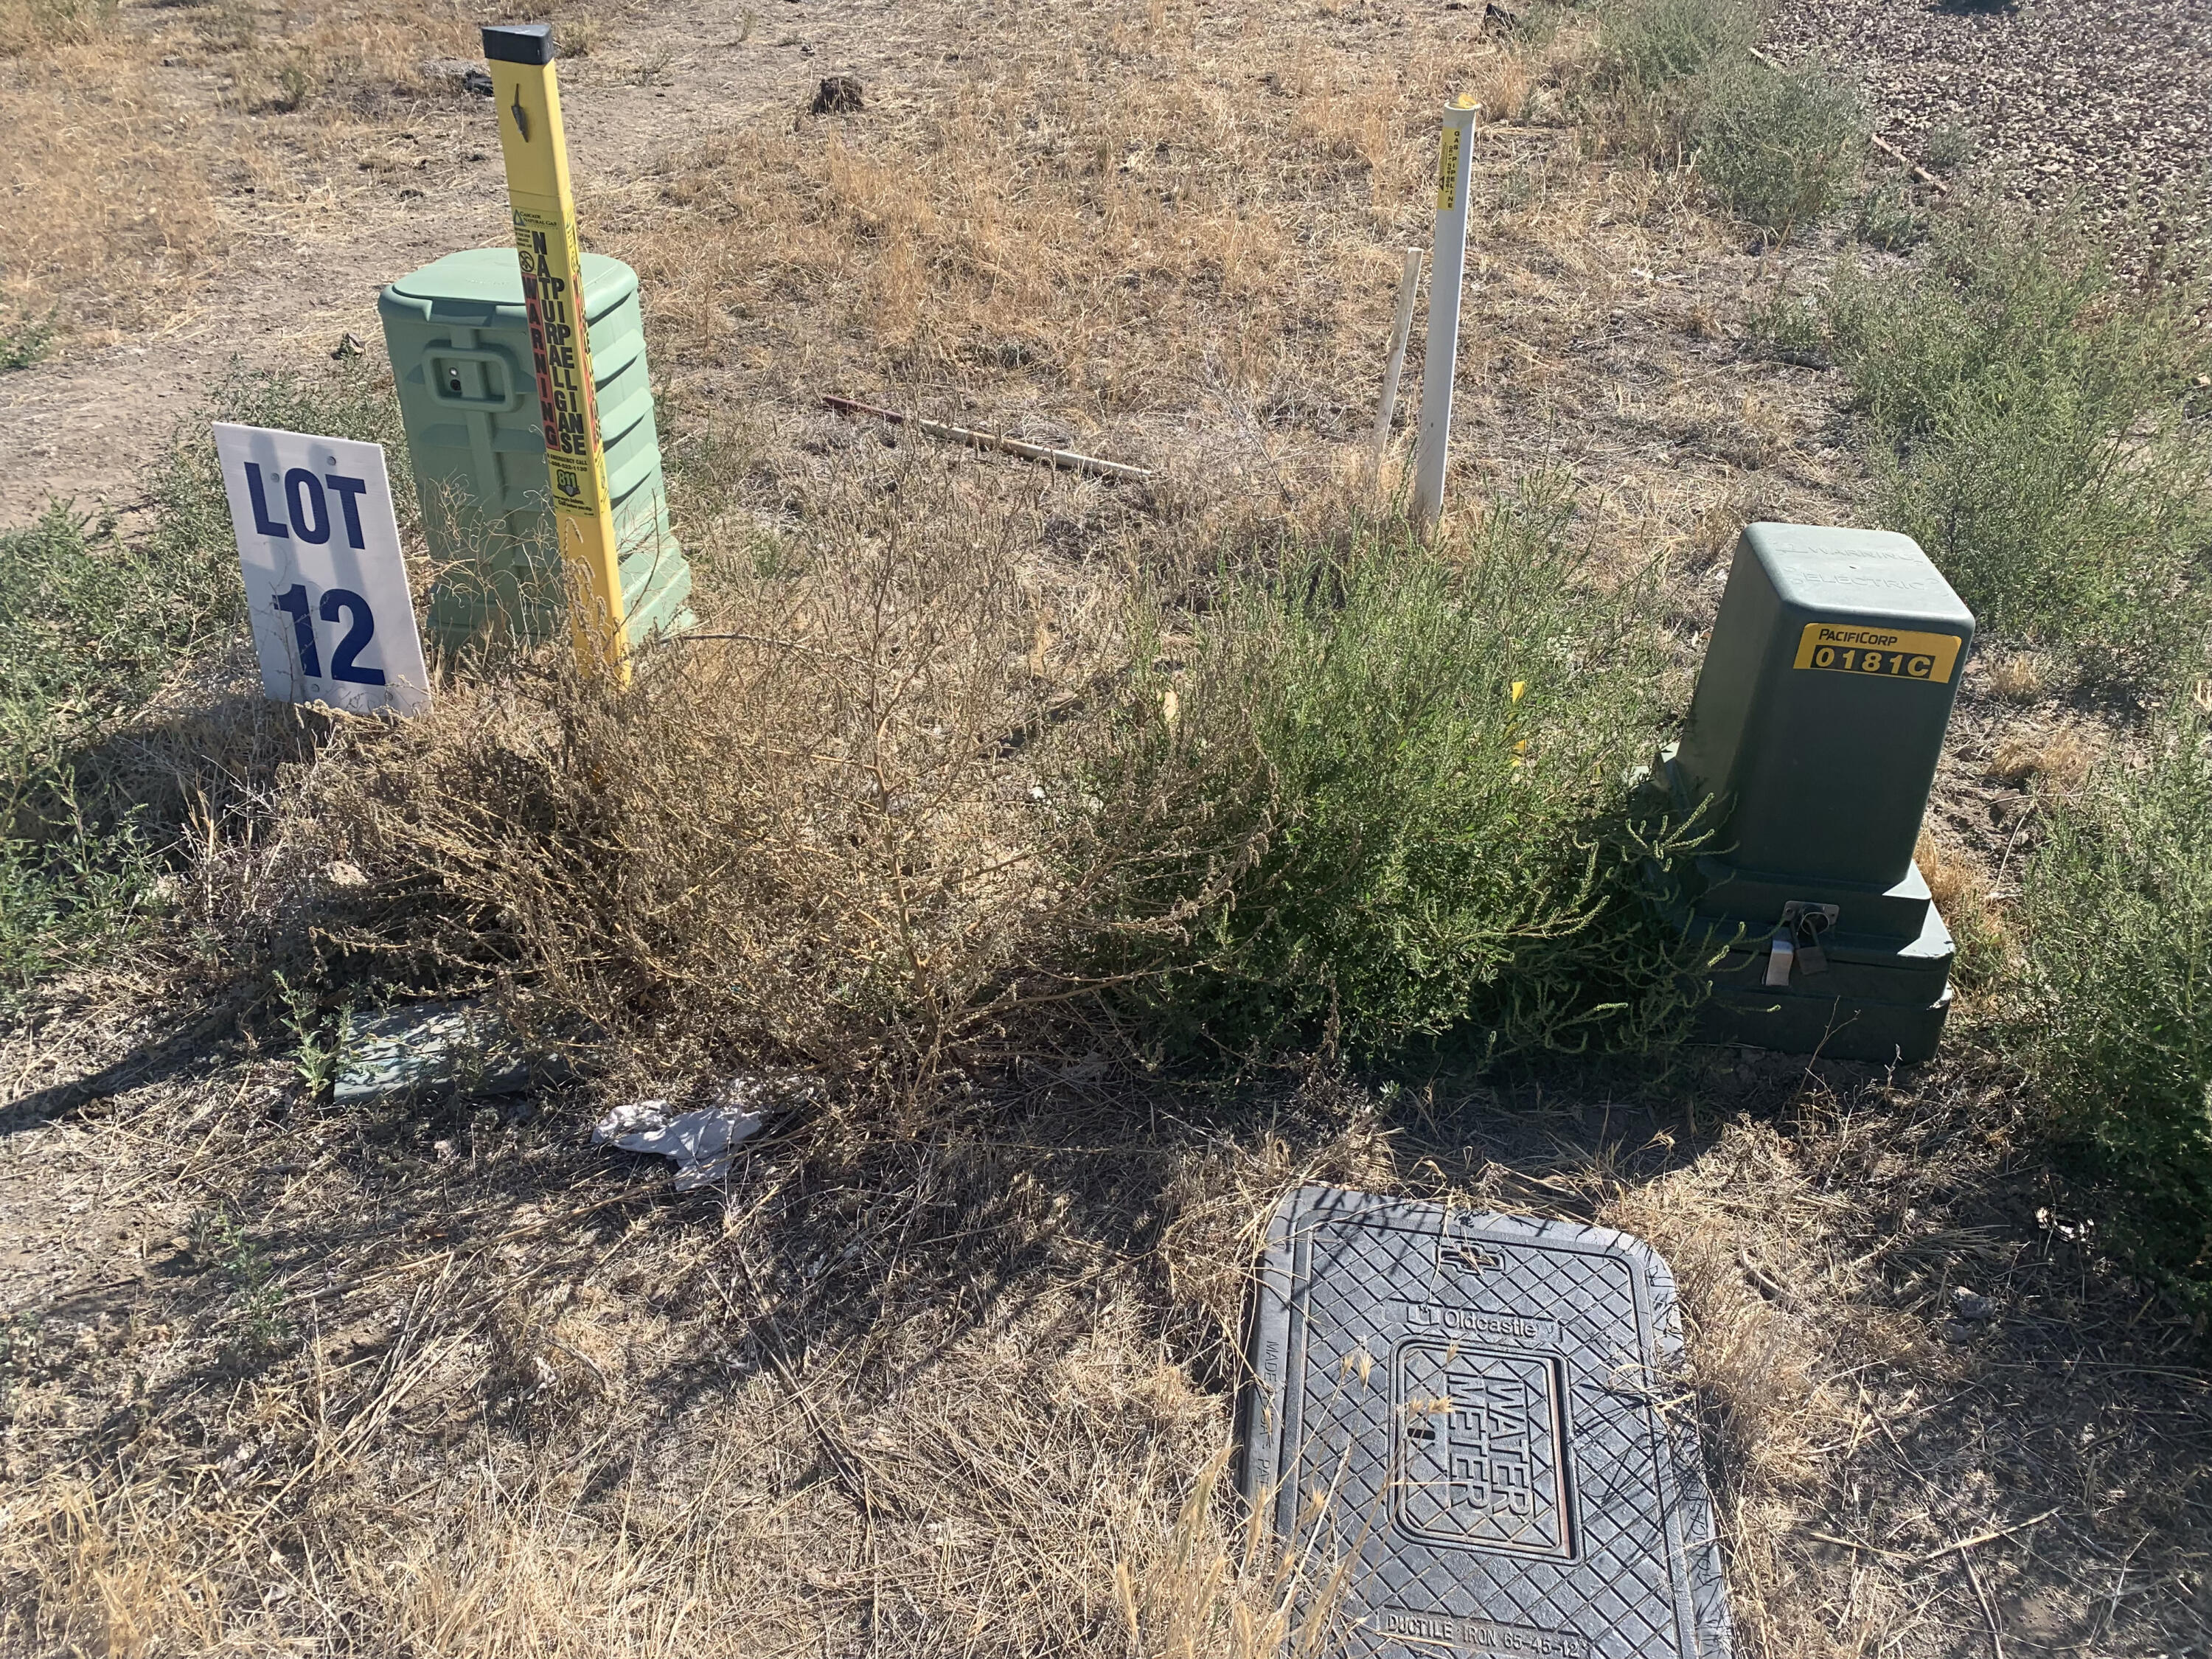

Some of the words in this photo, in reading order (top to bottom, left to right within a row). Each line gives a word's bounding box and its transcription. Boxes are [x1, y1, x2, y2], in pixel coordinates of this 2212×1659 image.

[1447, 157, 1456, 207] PIPELINE
[522, 275, 558, 447] WARNING
[551, 277, 587, 456] PIPELINE
[557, 469, 577, 488] 811
[244, 462, 366, 550] LOT
[1803, 573, 1926, 591] ELECTRIC
[271, 583, 386, 686] 12
[1815, 647, 1931, 678] 0181C
[1443, 1309, 1537, 1338] Oldcastle
[1264, 1340, 1279, 1383] MADE
[1447, 1375, 1489, 1509] METER
[1485, 1384, 1532, 1516] WATER
[1387, 1614, 1453, 1641] DUCTILE
[1462, 1624, 1497, 1647] IRON
